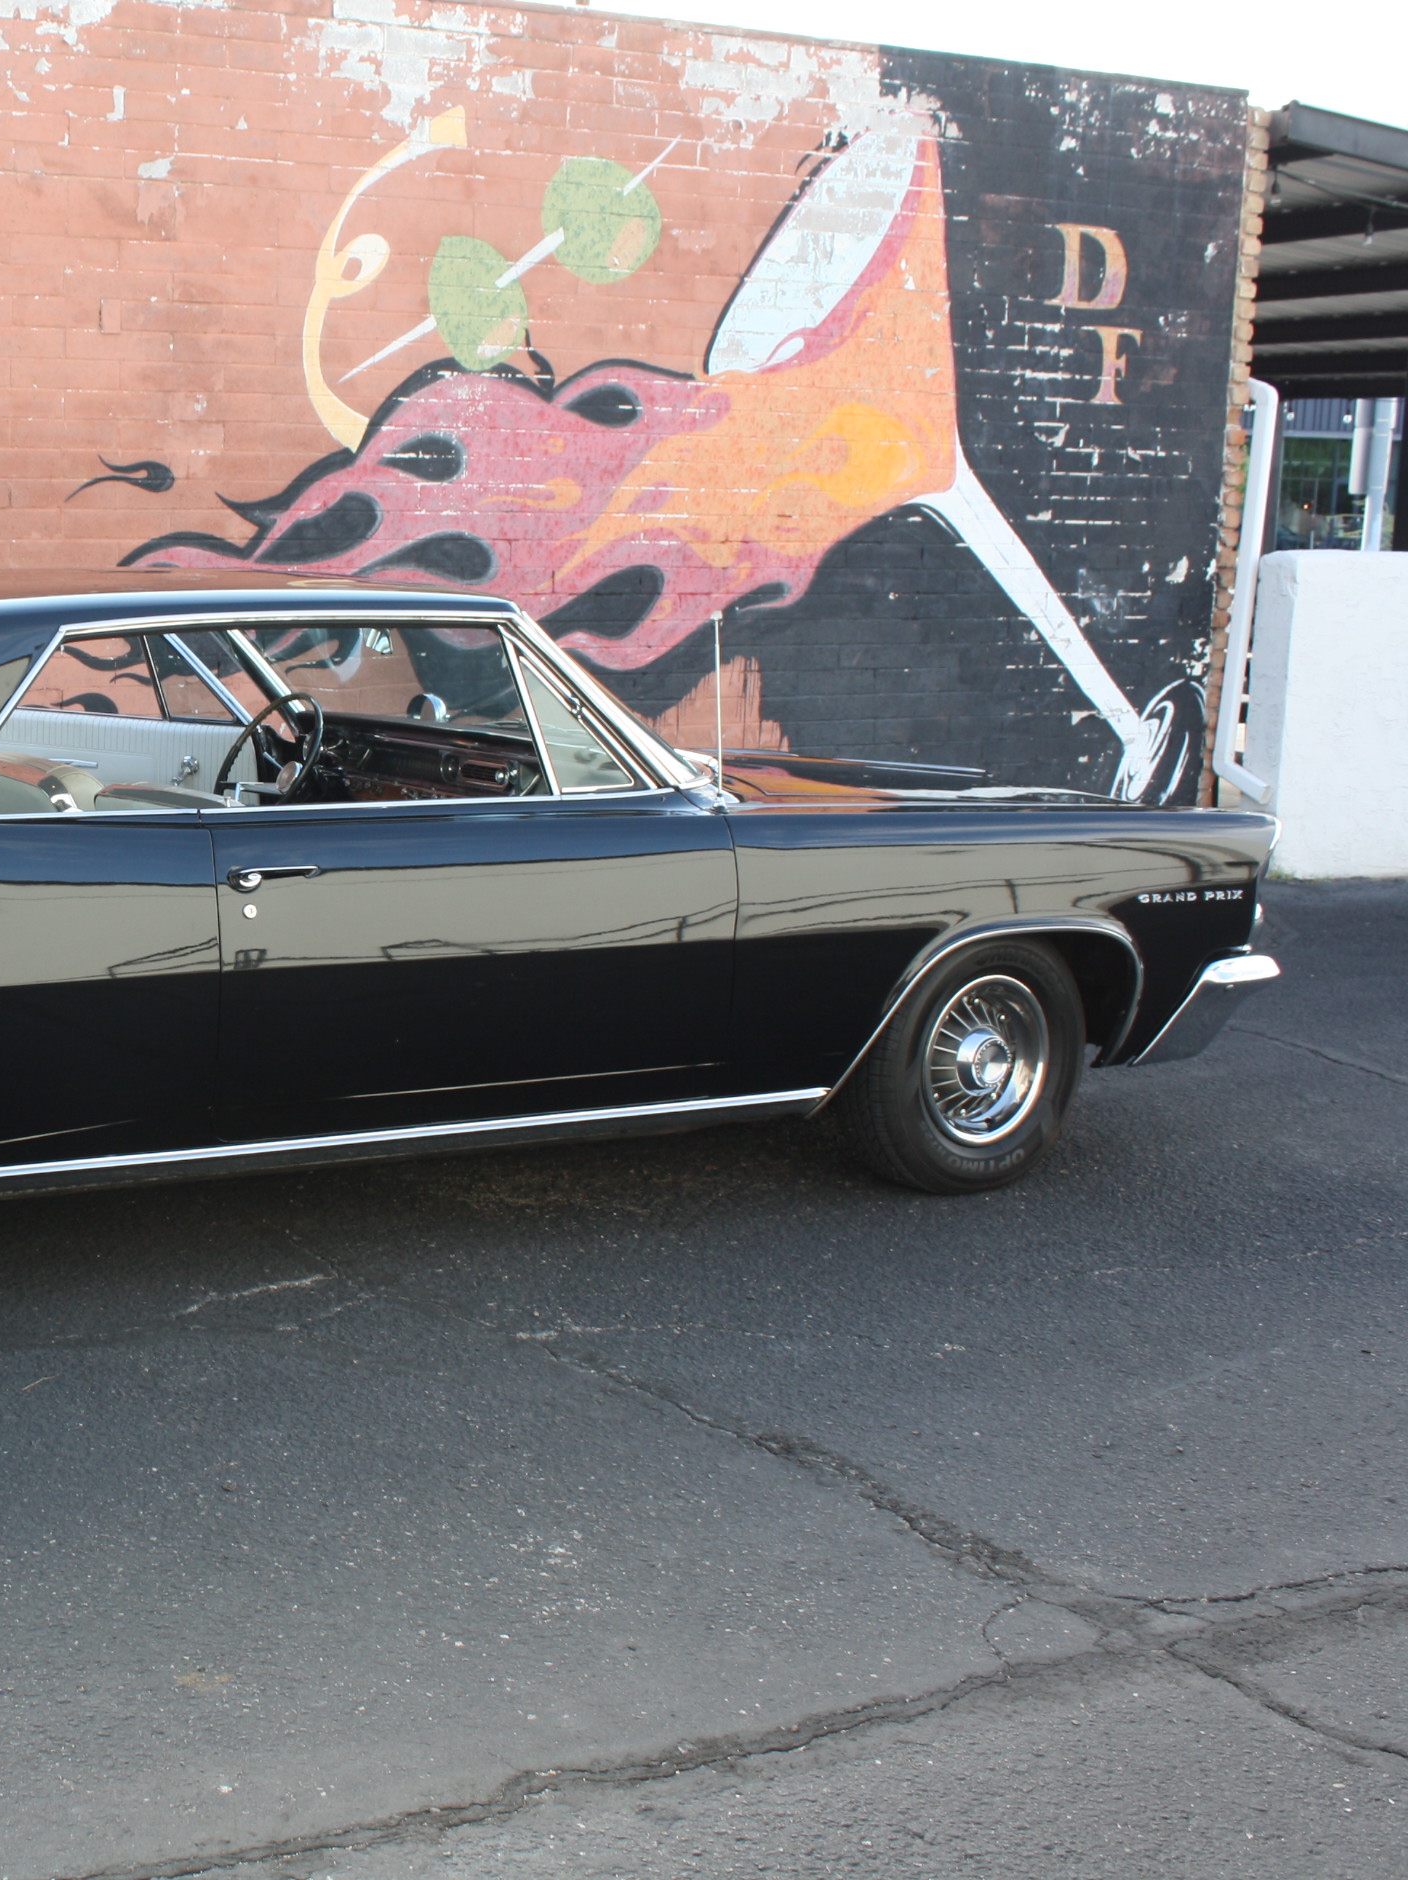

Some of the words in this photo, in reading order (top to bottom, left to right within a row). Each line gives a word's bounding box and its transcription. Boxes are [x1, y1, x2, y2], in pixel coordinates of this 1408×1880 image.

[1045, 222, 1128, 309] D
[1088, 326, 1143, 405] F
[1137, 891, 1198, 904] GRAND
[1203, 889, 1244, 901] PRIX
[946, 1147, 1025, 1174] OPTIMO
